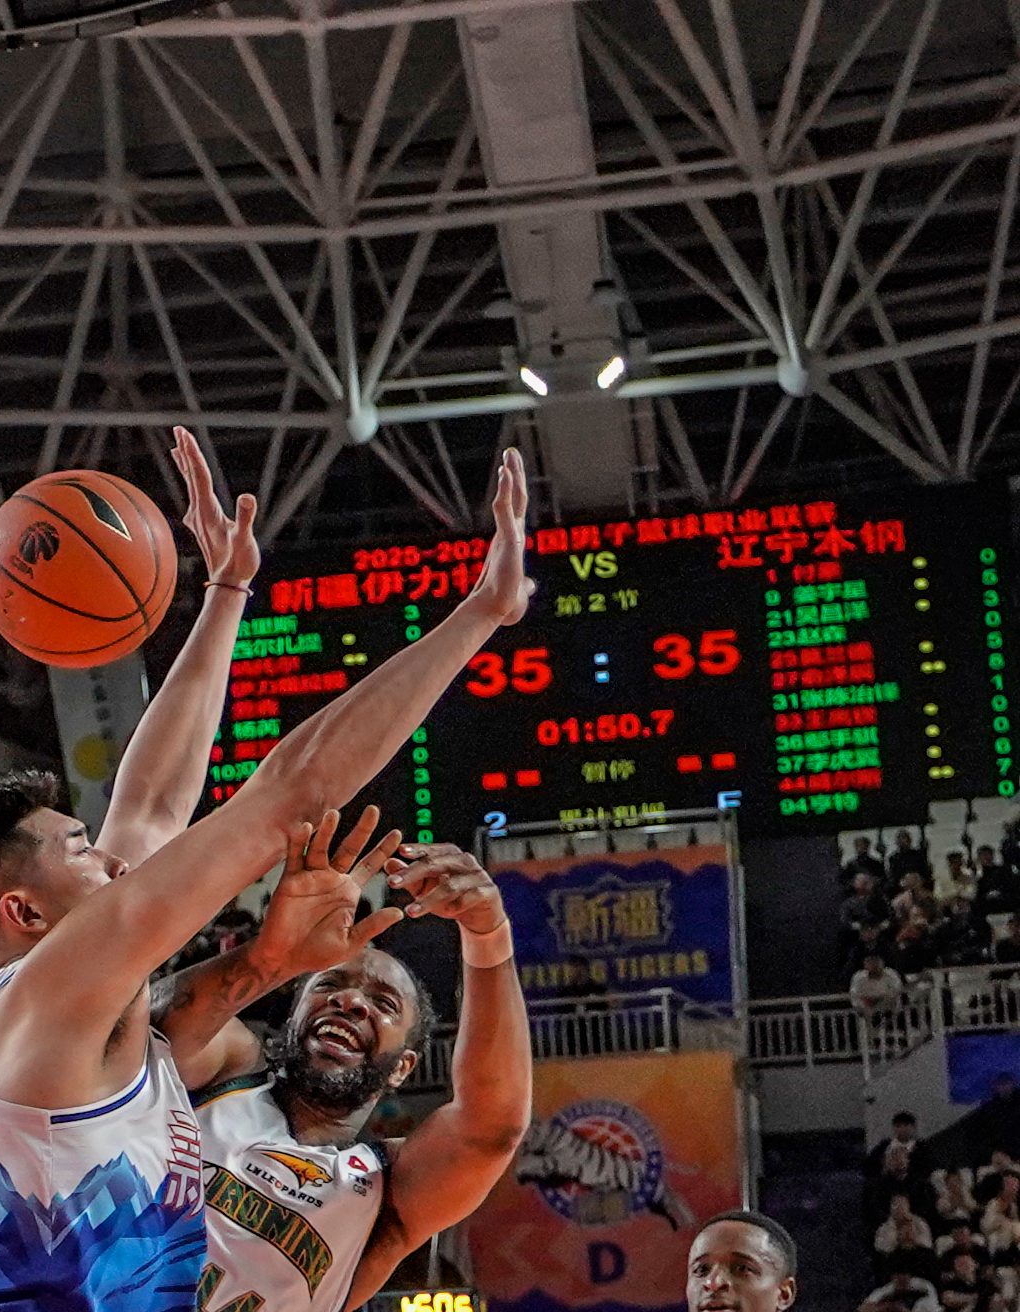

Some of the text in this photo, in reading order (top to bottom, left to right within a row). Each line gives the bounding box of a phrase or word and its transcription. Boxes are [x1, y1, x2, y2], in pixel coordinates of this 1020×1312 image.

[718, 520, 906, 569] 辽宁本钢
[568, 551, 618, 579] VS
[980, 547, 997, 565] 0
[588, 593, 607, 612] 2
[985, 610, 1002, 628] 0
[405, 624, 422, 641] 0
[467, 647, 553, 698] 35
[652, 629, 742, 680] 35
[990, 674, 1004, 690] 1
[991, 694, 1008, 712] 0
[537, 709, 675, 746] 01:50.7
[993, 715, 1010, 733] 0
[412, 747, 429, 764] 0
[996, 757, 1013, 776] 7
[415, 788, 431, 805] 0
[484, 811, 508, 838] 2
[261, 1170, 325, 1209] LEOPARDS
